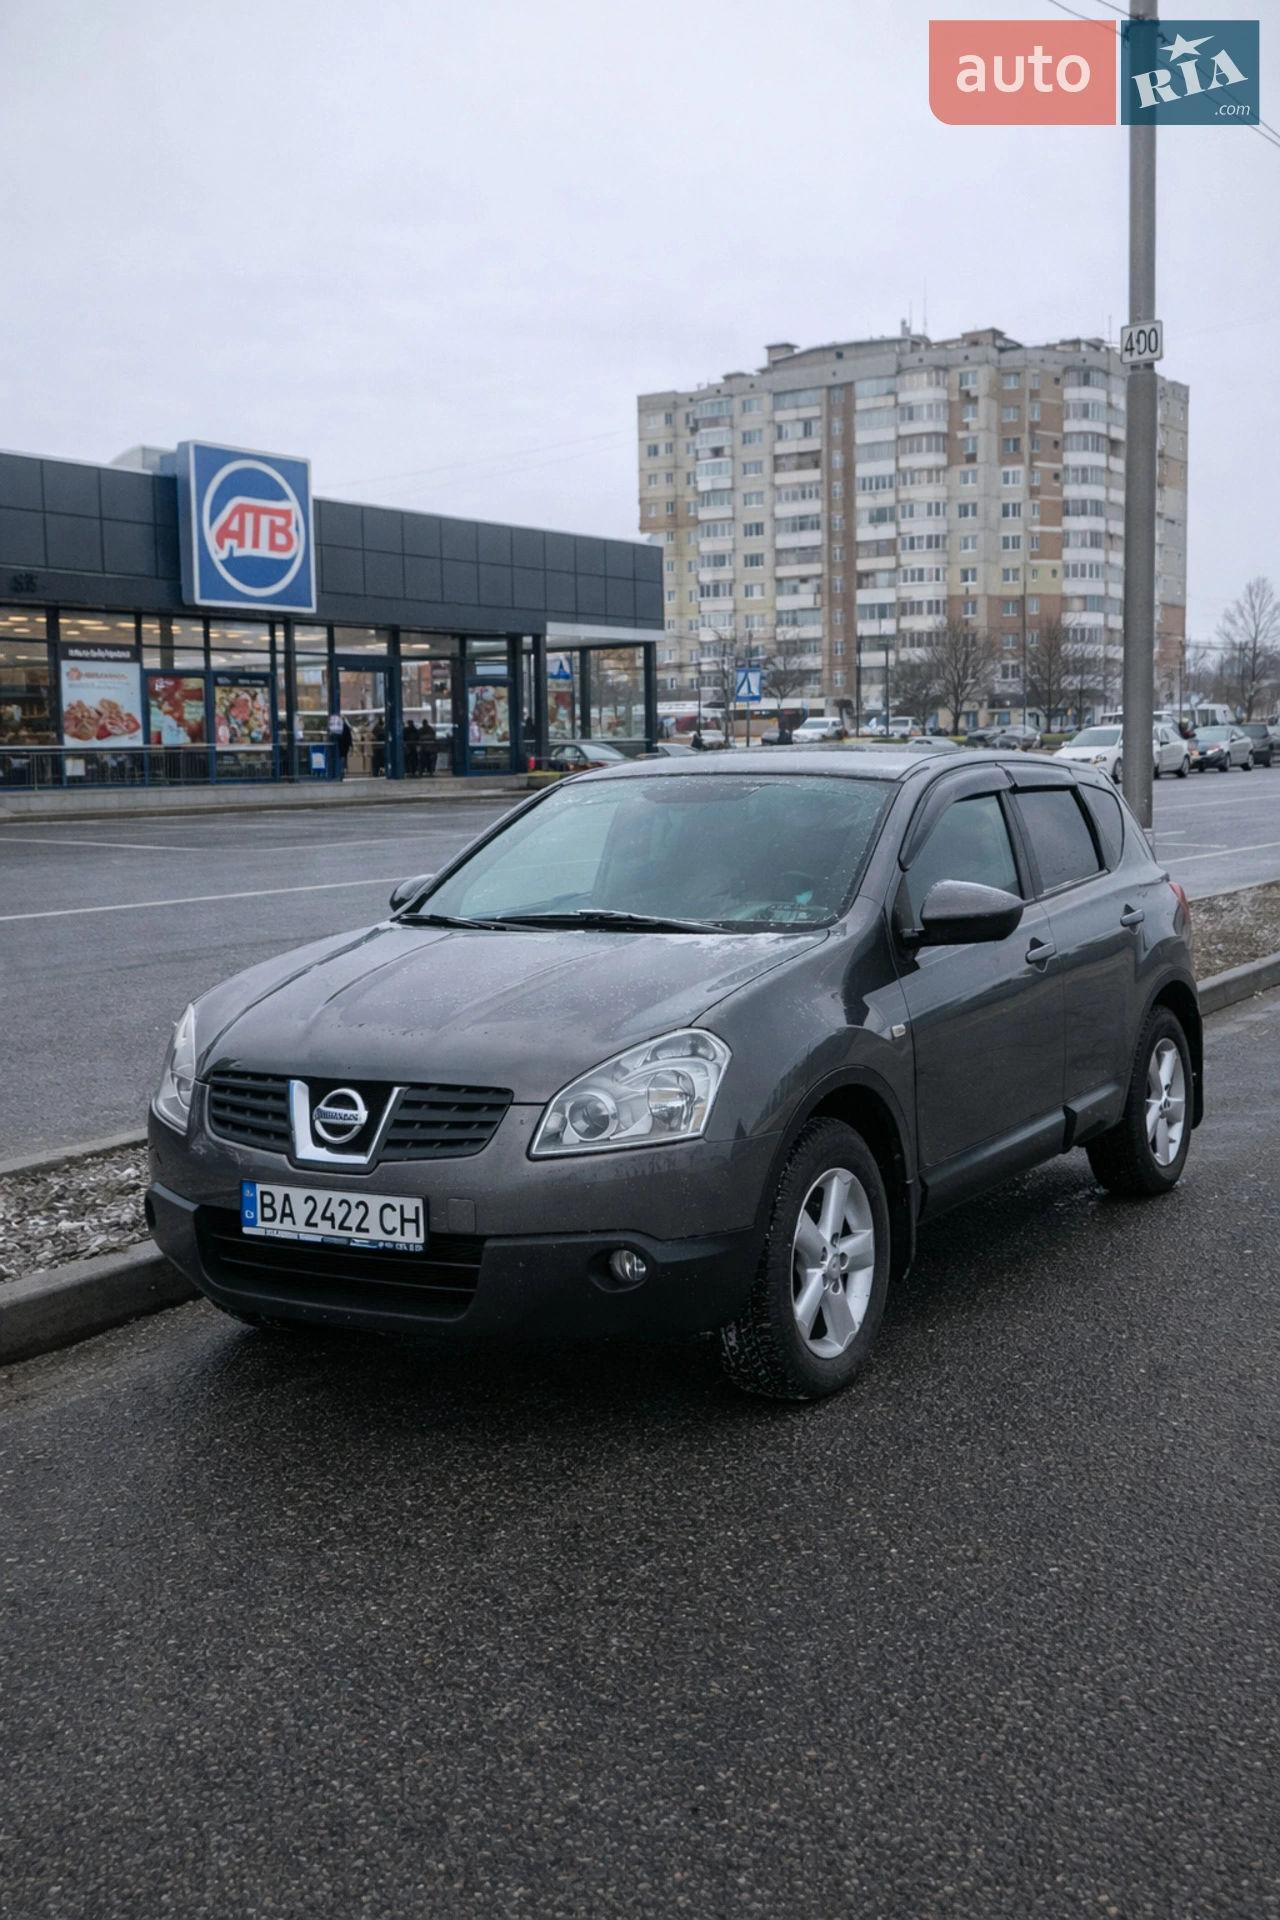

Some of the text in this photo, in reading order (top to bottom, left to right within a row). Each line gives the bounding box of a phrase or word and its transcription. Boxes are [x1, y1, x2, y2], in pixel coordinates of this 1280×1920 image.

[259, 1191, 420, 1238] BA 2422 CH
